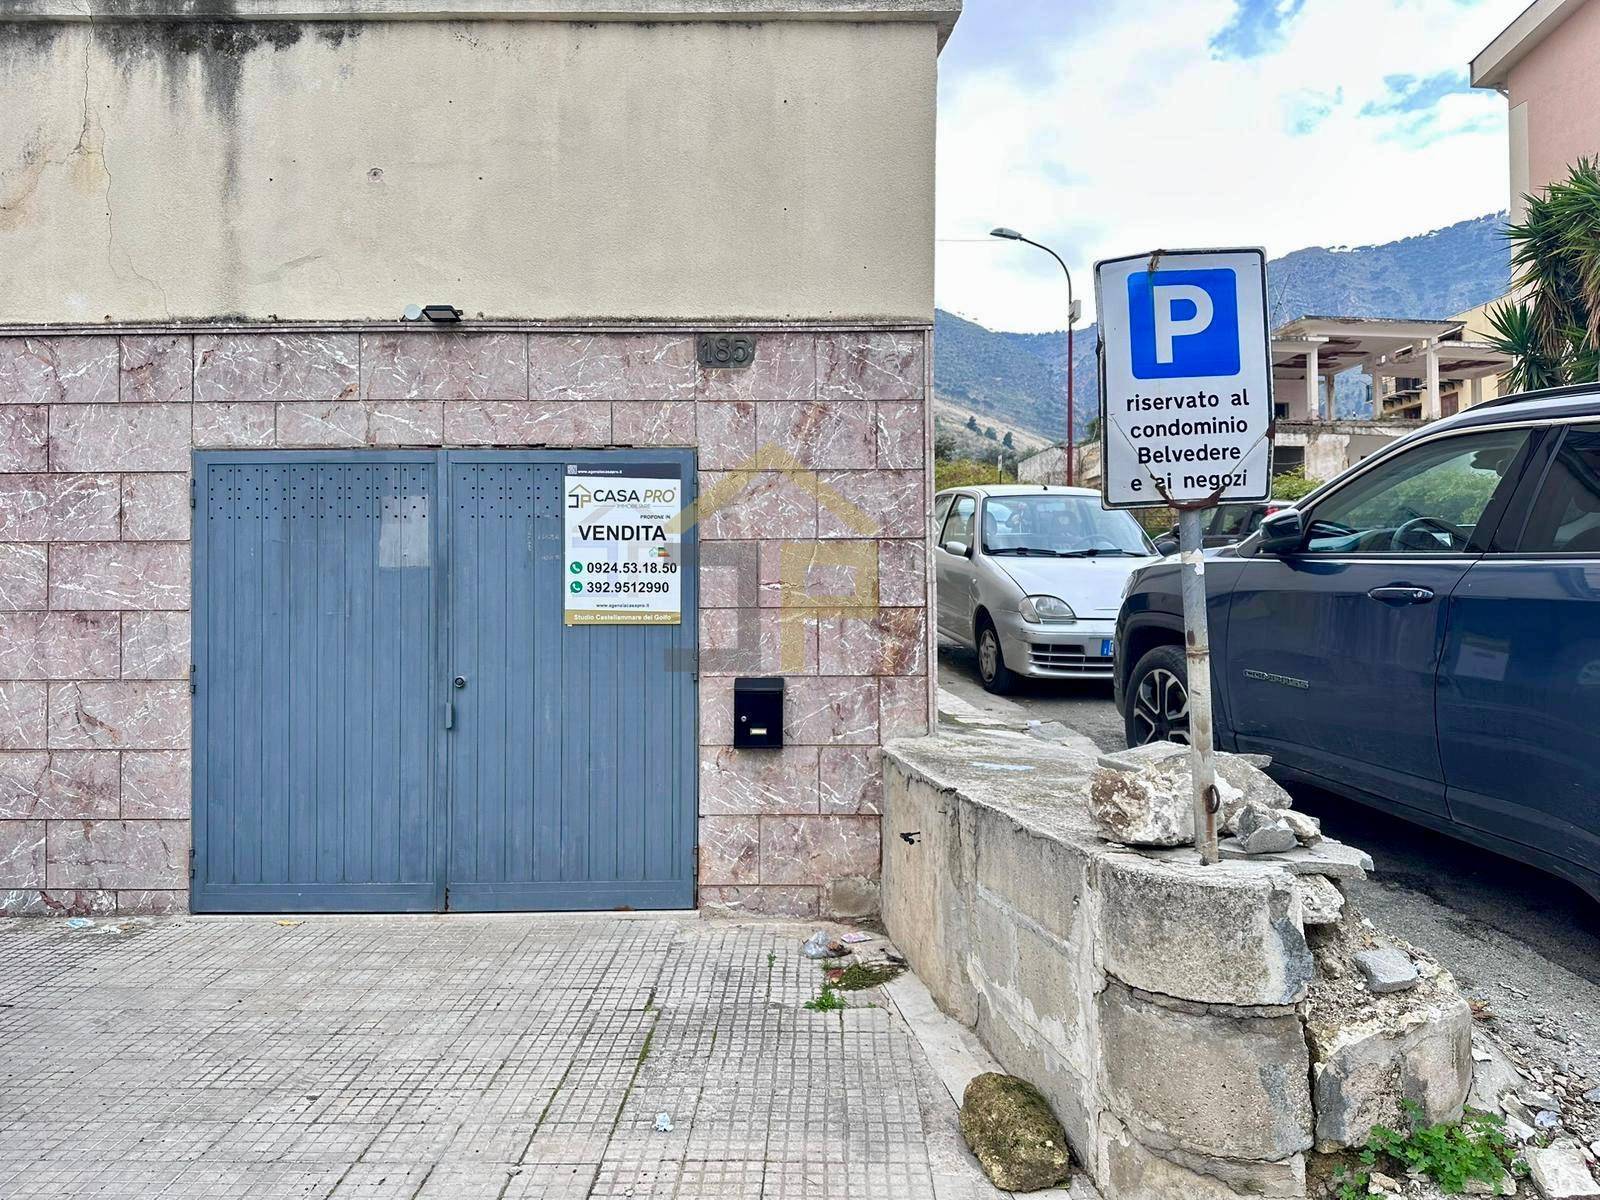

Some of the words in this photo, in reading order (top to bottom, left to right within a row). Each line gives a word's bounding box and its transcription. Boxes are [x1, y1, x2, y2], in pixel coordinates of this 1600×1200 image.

[1153, 284, 1214, 364] P
[702, 337, 750, 363] 185
[1127, 391, 1219, 412] riservato
[1230, 388, 1250, 406] al
[1130, 416, 1248, 439] condominio
[1138, 444, 1241, 465] Belvedere
[1131, 478, 1143, 491] e
[1183, 469, 1248, 491] negozi
[593, 489, 640, 503] CASA
[643, 489, 675, 503] PRO
[578, 525, 667, 541] VENDITA
[586, 562, 677, 574] 0924.53.18.50
[586, 581, 670, 593] 392.9512990
